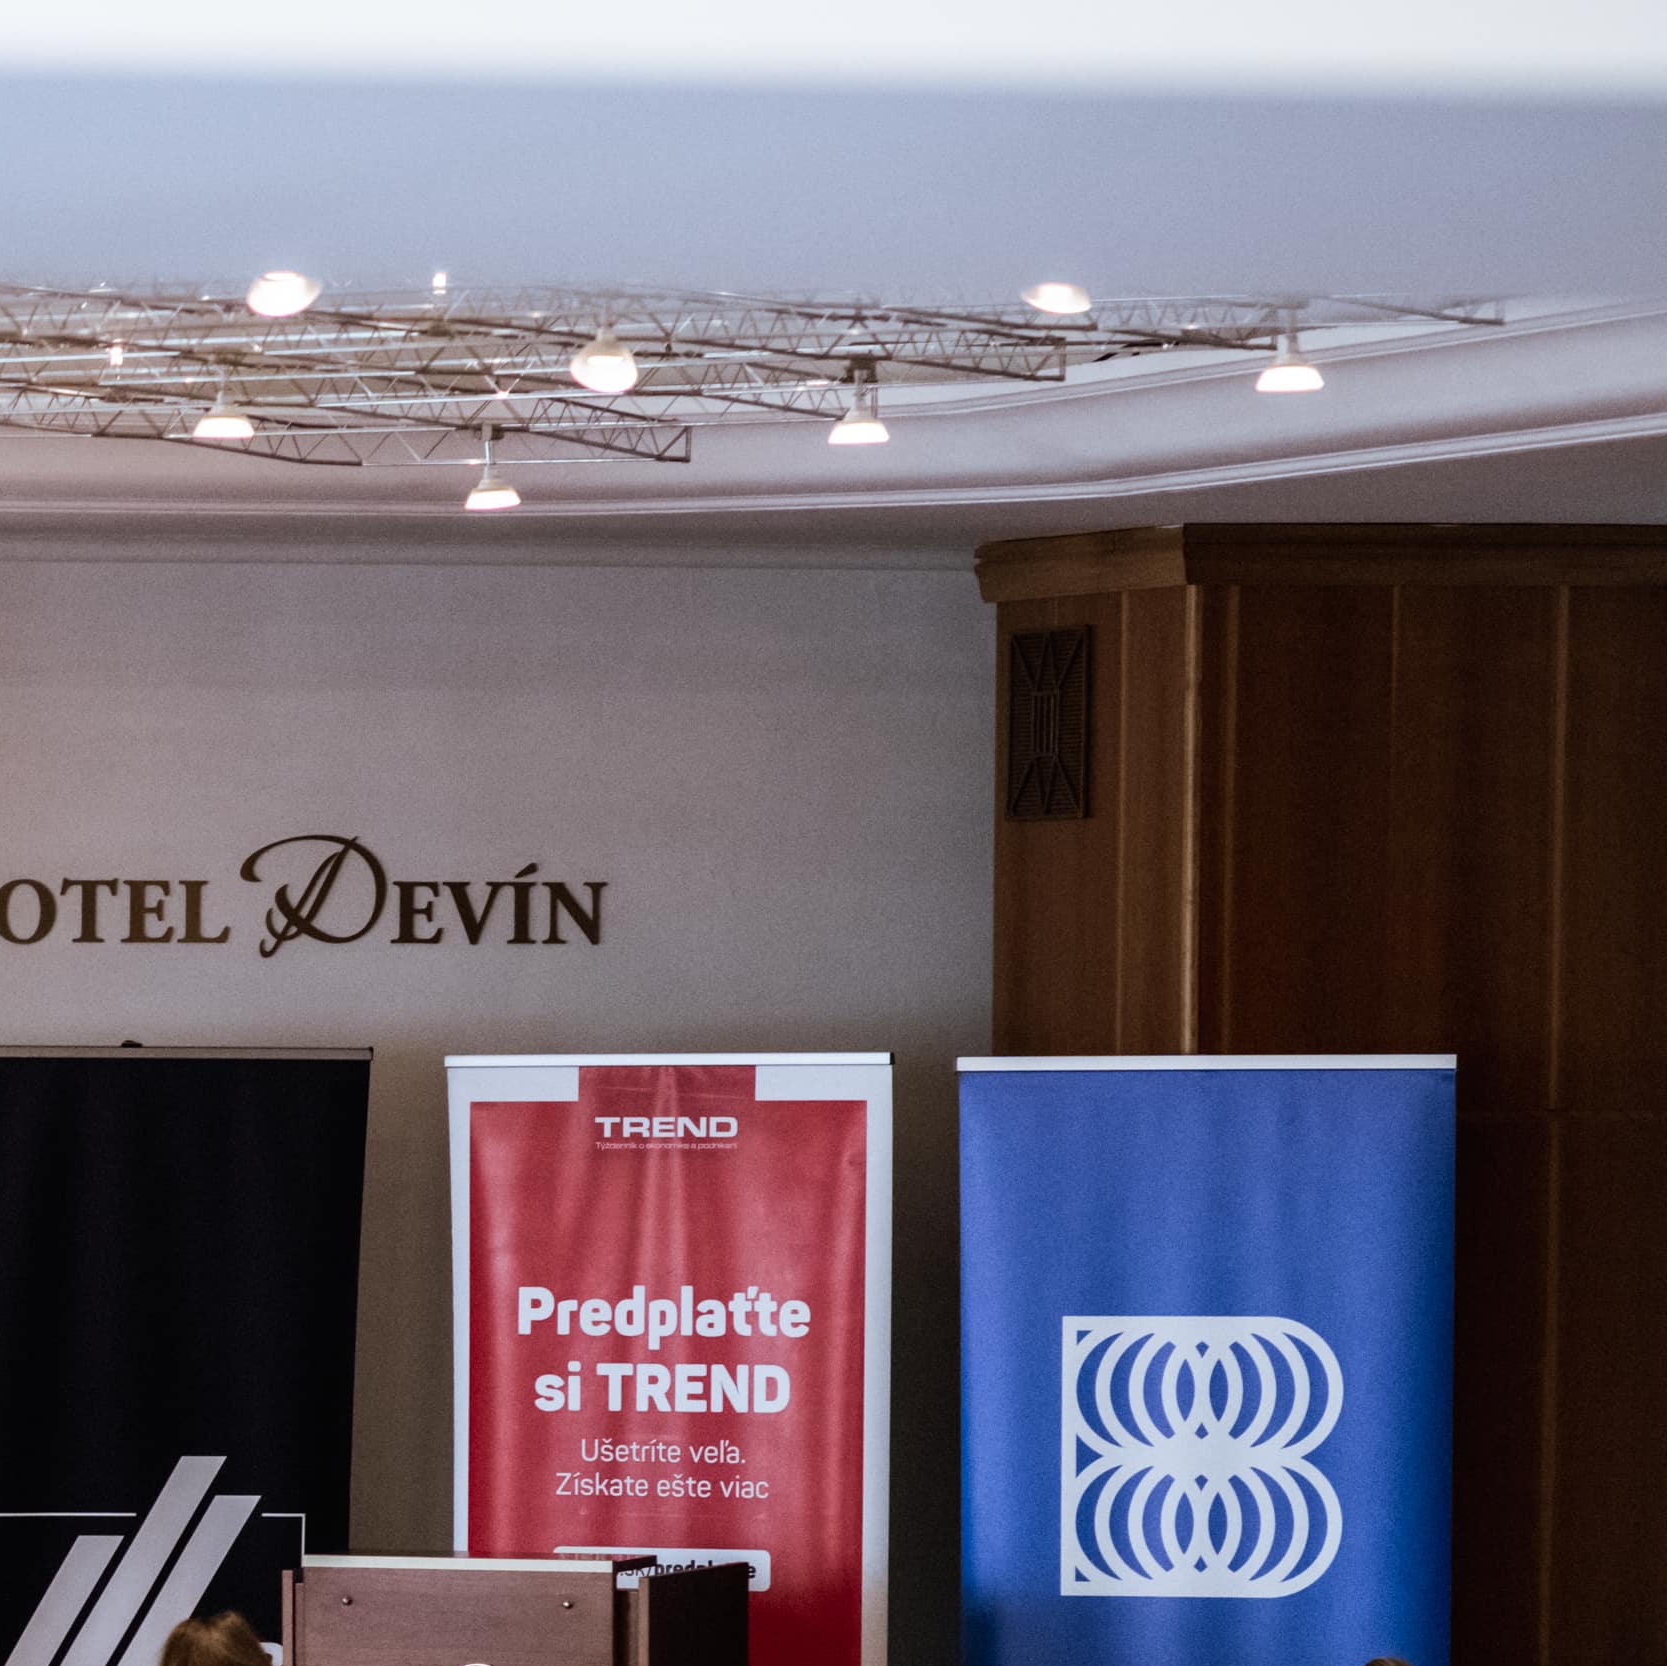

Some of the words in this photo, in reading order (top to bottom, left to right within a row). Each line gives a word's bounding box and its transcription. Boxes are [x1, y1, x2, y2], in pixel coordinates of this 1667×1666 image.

[240, 834, 608, 958] DEVÍN
[594, 1116, 738, 1138] TREND
[517, 1285, 811, 1350] Predplaťte
[534, 1361, 581, 1412] si
[596, 1363, 791, 1413] TREND
[580, 1438, 681, 1463] Ušetríte
[689, 1440, 746, 1464] veľa.
[556, 1472, 650, 1496] Získate
[656, 1476, 712, 1498] ešte
[720, 1476, 769, 1499] viac
